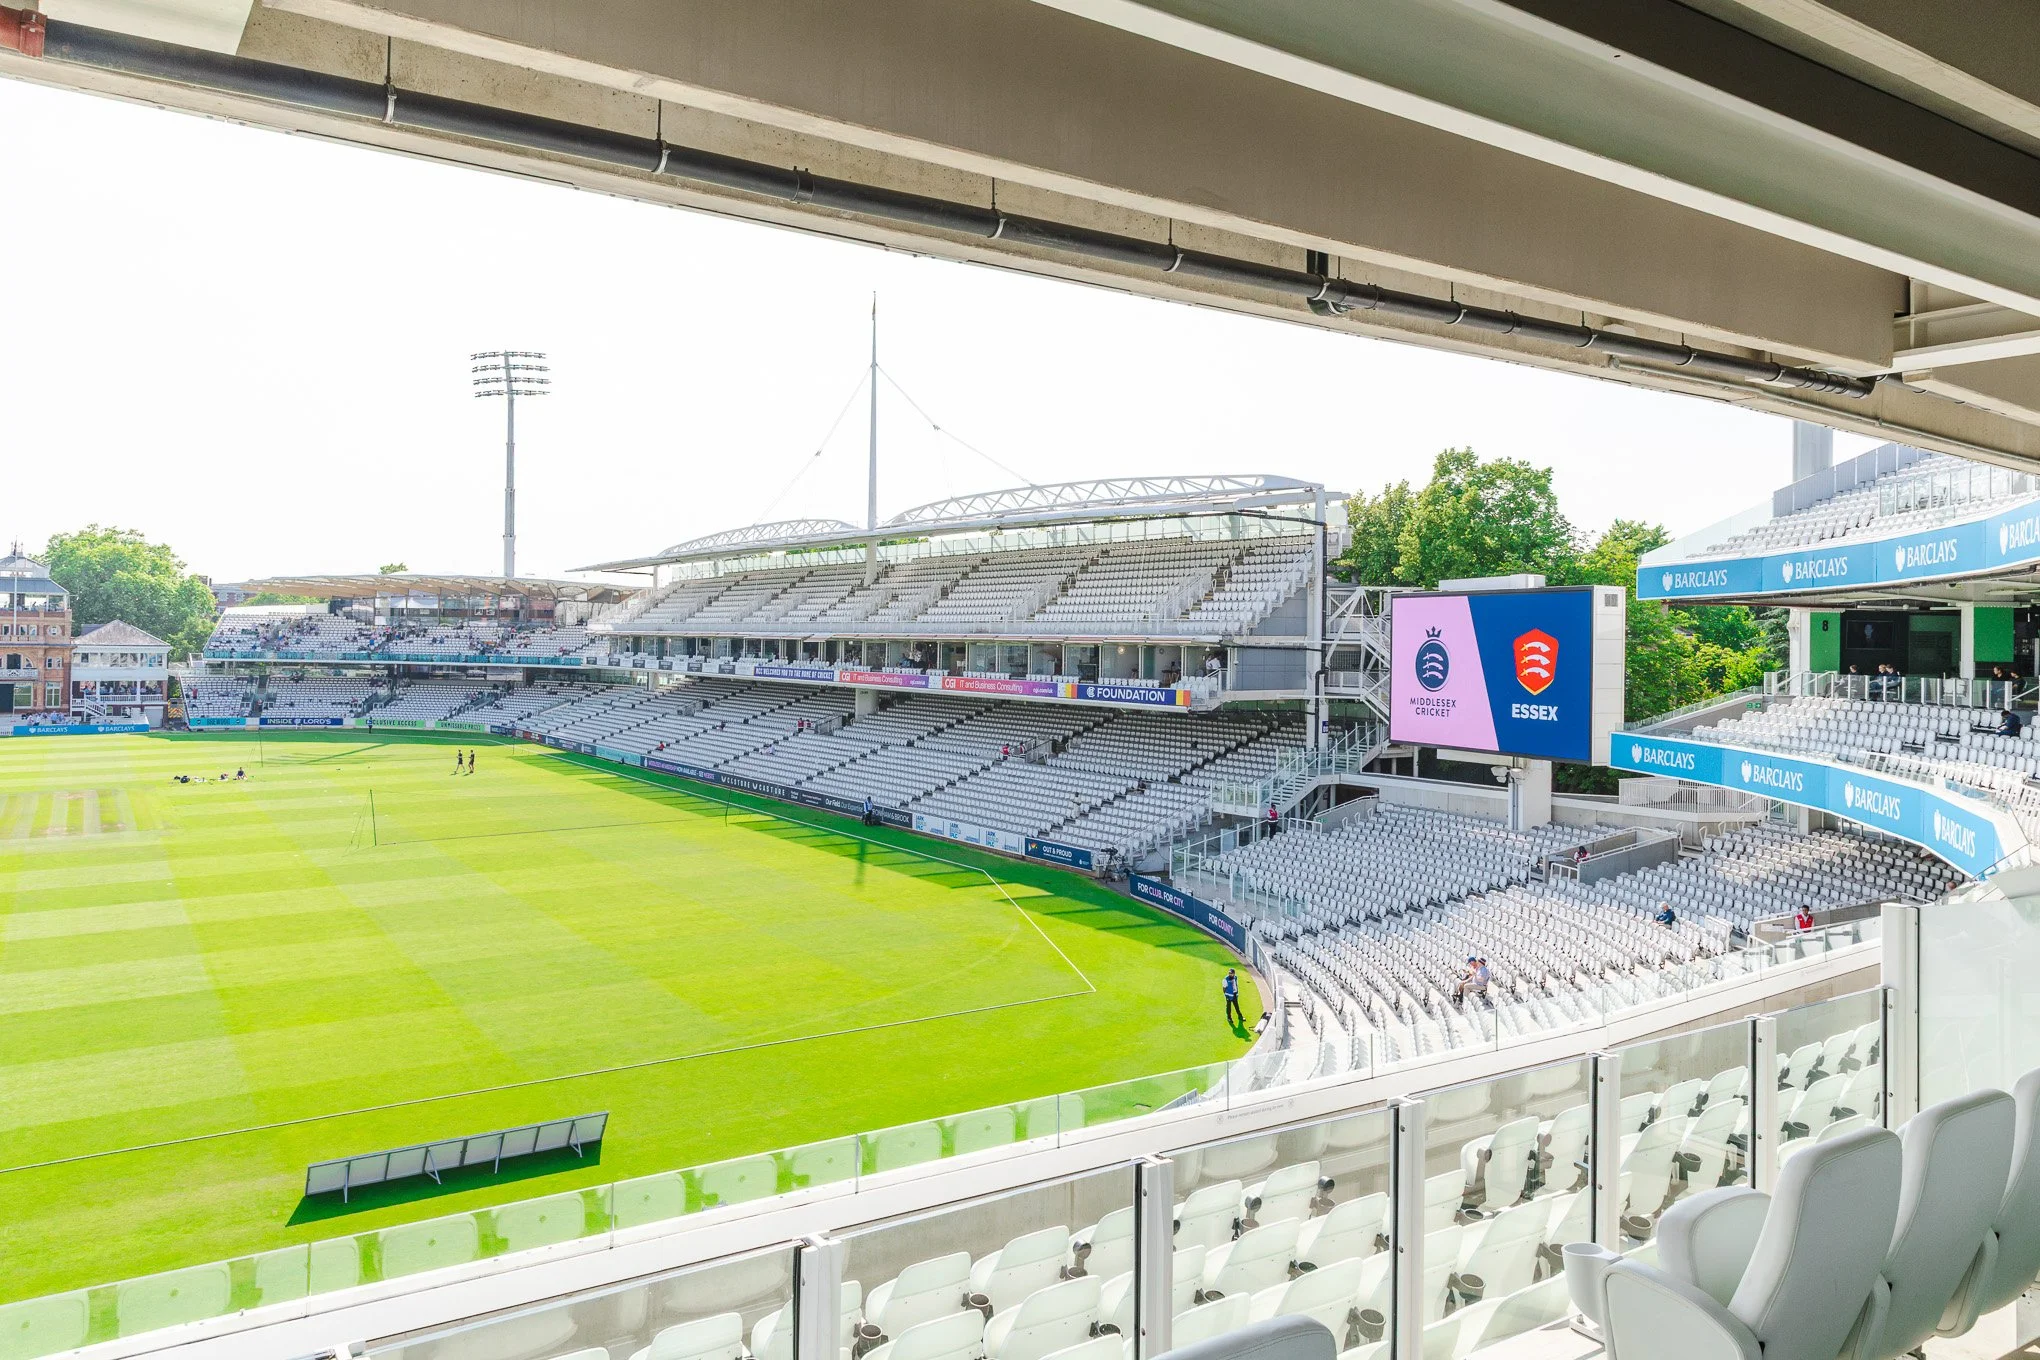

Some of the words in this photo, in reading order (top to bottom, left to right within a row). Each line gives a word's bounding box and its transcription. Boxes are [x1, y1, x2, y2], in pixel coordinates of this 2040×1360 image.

[1906, 538, 1957, 568] BARCLAYS
[1796, 556, 1848, 580] BARCLAYS
[1674, 570, 1728, 588] BARCLAYS
[1822, 620, 1828, 632] 8
[842, 673, 850, 681] CGI
[882, 676, 902, 685] Consulting
[945, 679, 955, 688] CGI
[960, 680, 964, 688] IT
[965, 680, 974, 688] and
[975, 682, 995, 690] Business
[997, 683, 1023, 693] Consulting
[1097, 688, 1165, 702] FOUNDATION
[1410, 698, 1456, 708] MIDDLESEX
[1416, 708, 1450, 717] CRICKET
[1512, 704, 1558, 721] ESSEX
[1644, 747, 1695, 770] BARCLAYS
[1753, 764, 1803, 792] BARCLAYS
[1855, 788, 1900, 820] BARCLAYS
[894, 814, 909, 823] BROOK
[1942, 816, 1975, 858] BARCLAYS
[1056, 849, 1072, 858] PROUD
[1138, 883, 1148, 894] FOR
[1149, 886, 1163, 899] CLUB.
[1163, 892, 1173, 903] FOR
[1174, 896, 1184, 908] CITY.
[1209, 913, 1218, 926] FOR
[1218, 919, 1234, 936] COUNTY.
